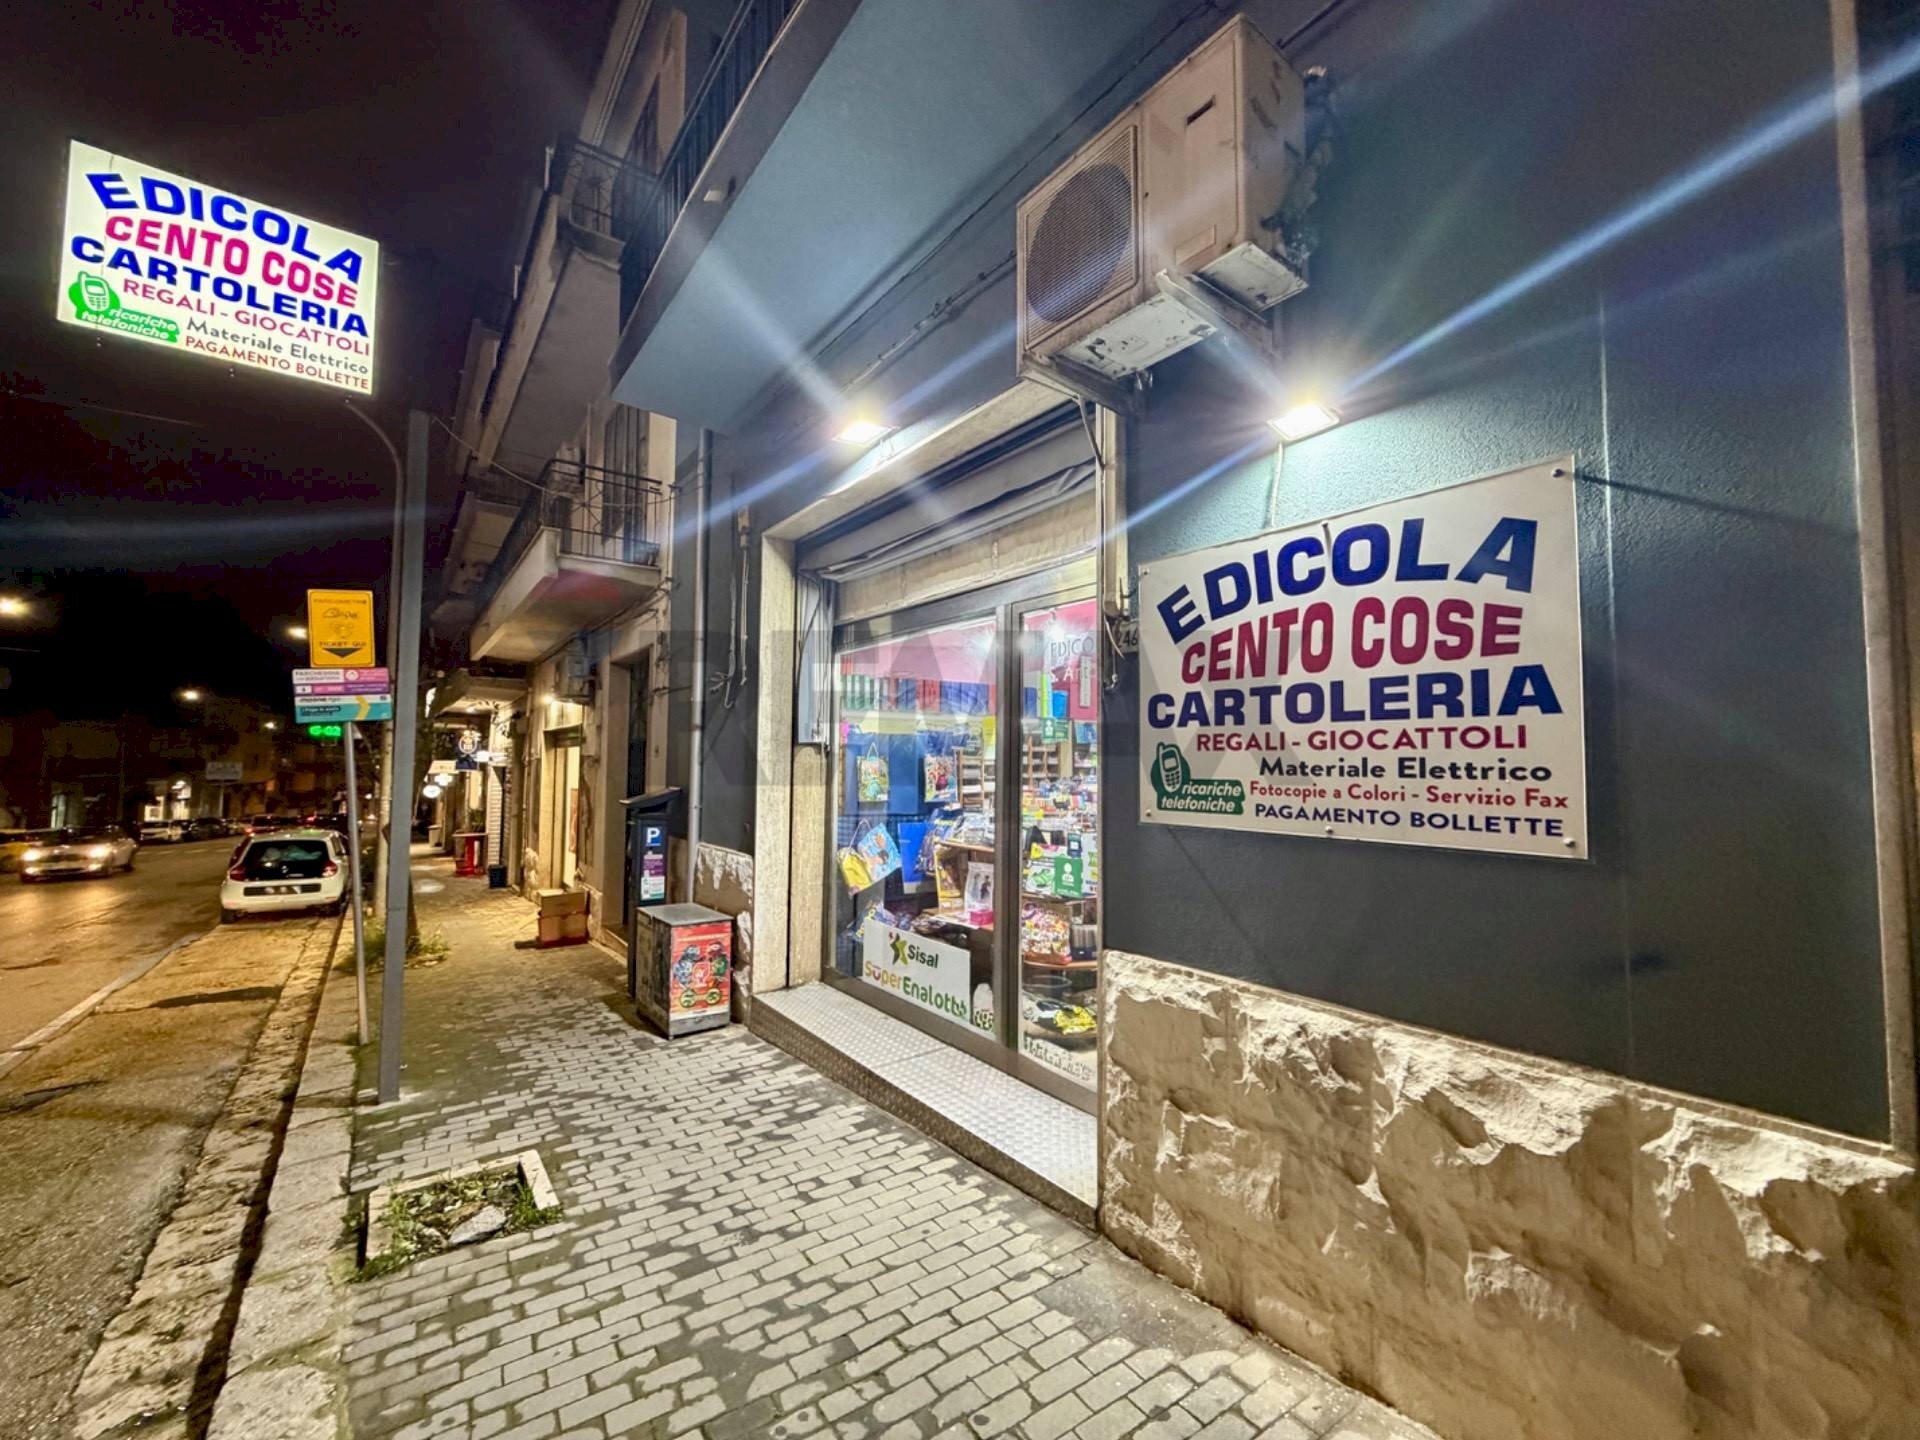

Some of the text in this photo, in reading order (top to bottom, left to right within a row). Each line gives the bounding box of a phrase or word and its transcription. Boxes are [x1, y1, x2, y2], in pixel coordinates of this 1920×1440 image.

[86, 172, 363, 285] EDICOLA
[105, 215, 359, 308] CENTO COSE
[70, 235, 369, 338] CARTOLERIA
[81, 311, 170, 341] telefoniche
[108, 307, 178, 332] ricariche
[123, 278, 216, 317] REGALI
[234, 309, 370, 357] GIOCATTOLI
[184, 334, 370, 390] PAGAMENTO BOLLETTE
[187, 316, 369, 375] Materiale Elettrico
[1156, 516, 1538, 645] EDICOLA
[1181, 600, 1334, 684] CENTO
[1350, 595, 1524, 669] COSE
[1147, 663, 1564, 729] CARTOLERIA
[1196, 731, 1286, 752] REGALI
[1307, 724, 1527, 751] GIOCATTOLI
[1259, 756, 1552, 782] Materiale Elettrico
[1161, 795, 1236, 813] telefoniche
[1182, 780, 1242, 797] ricariche
[1250, 780, 1327, 803] Fotocopie
[1333, 788, 1342, 799] a
[1347, 783, 1406, 802] Colori
[1426, 785, 1516, 807] Servizio
[1525, 788, 1569, 809] Fax
[646, 827, 661, 844] P
[1255, 803, 1564, 837] PAGAMENTO BOLLETTE
[907, 944, 939, 969] Sisal
